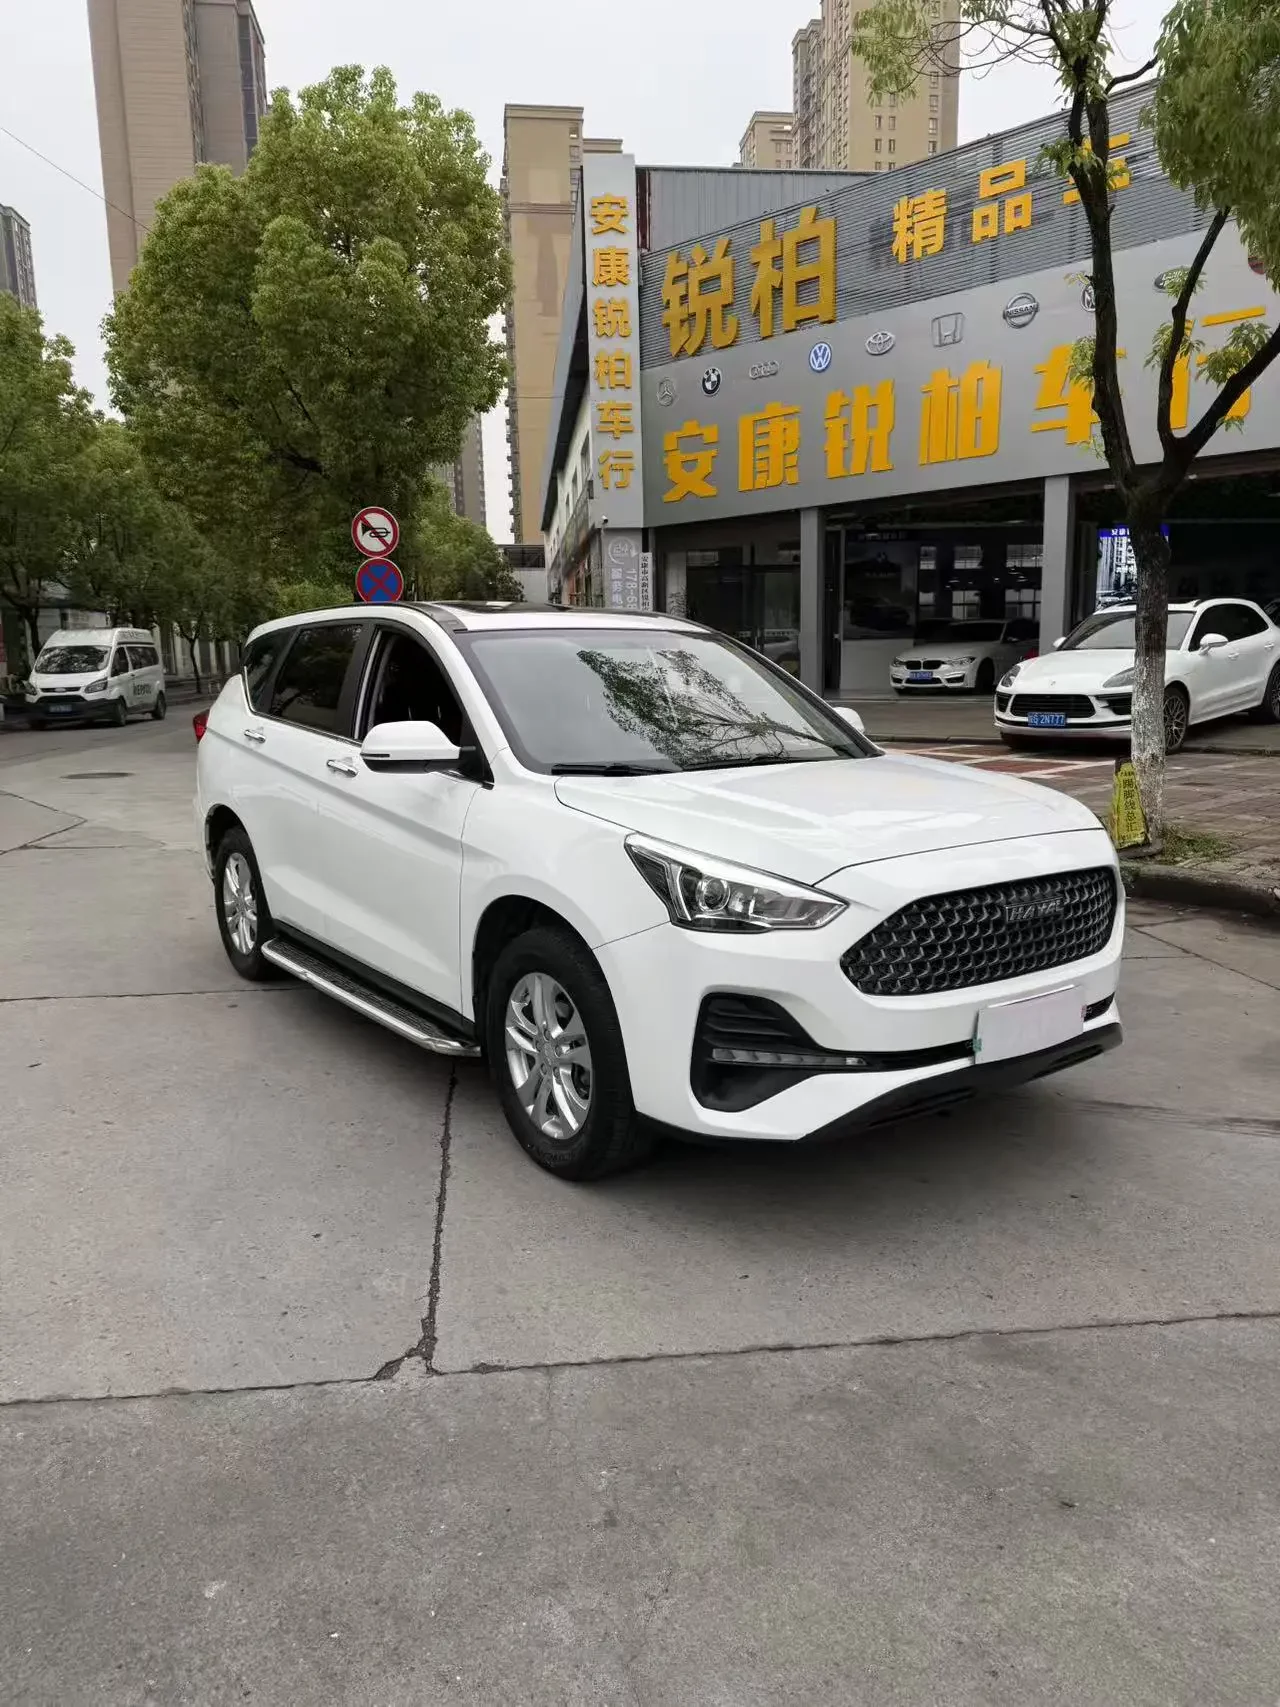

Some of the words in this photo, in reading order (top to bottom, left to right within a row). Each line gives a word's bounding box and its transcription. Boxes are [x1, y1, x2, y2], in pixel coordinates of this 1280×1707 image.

[590, 193, 635, 490] 安康锐柏车行
[661, 206, 838, 358] 锐柏
